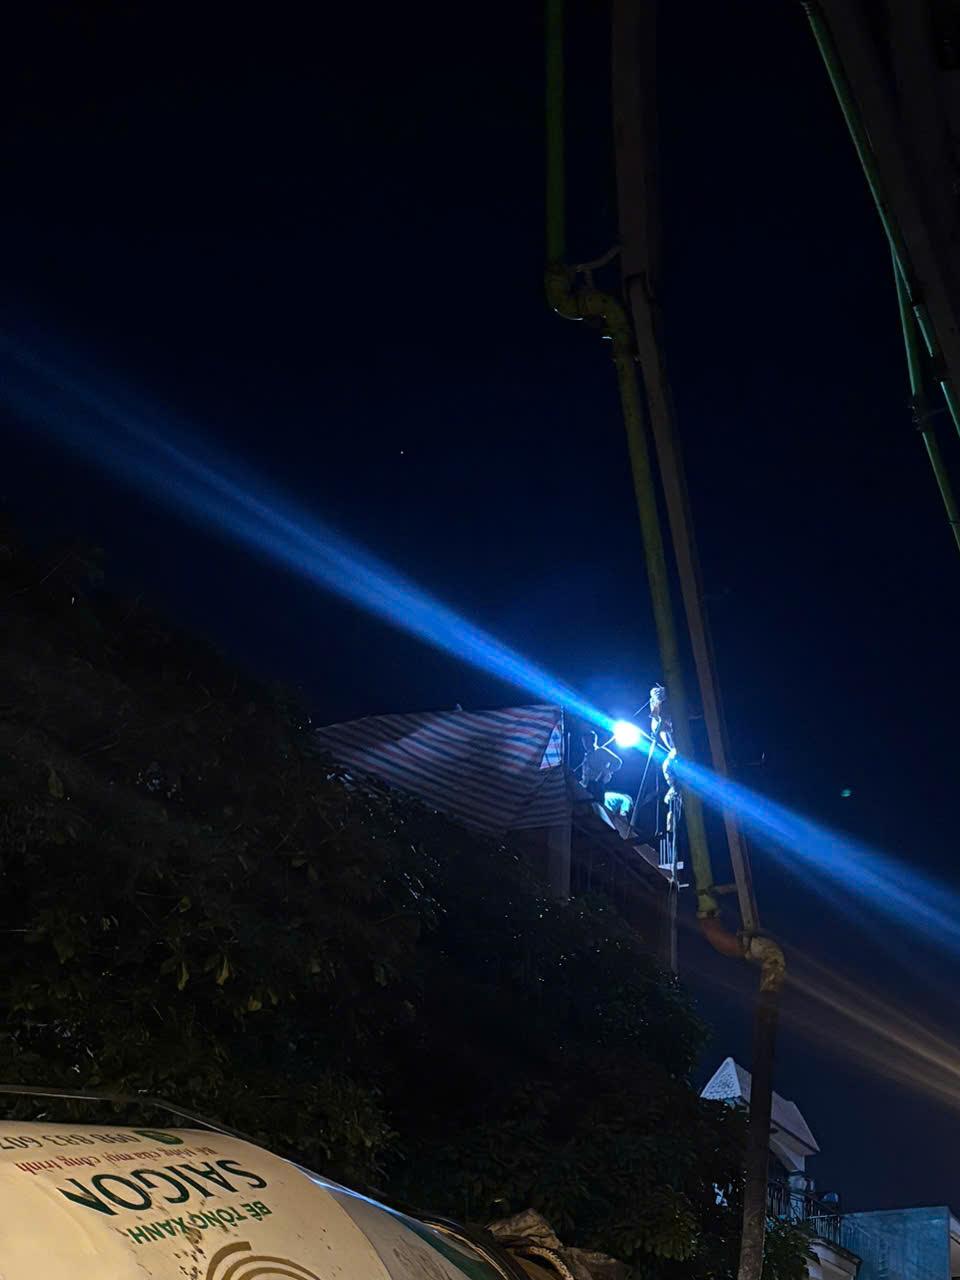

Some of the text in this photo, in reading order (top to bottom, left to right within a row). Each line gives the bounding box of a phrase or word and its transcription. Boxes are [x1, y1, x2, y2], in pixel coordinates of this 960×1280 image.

[15, 1157, 59, 1176] trình
[58, 1154, 102, 1170] công
[126, 1200, 273, 1245] BÊ TÔNG XANH
